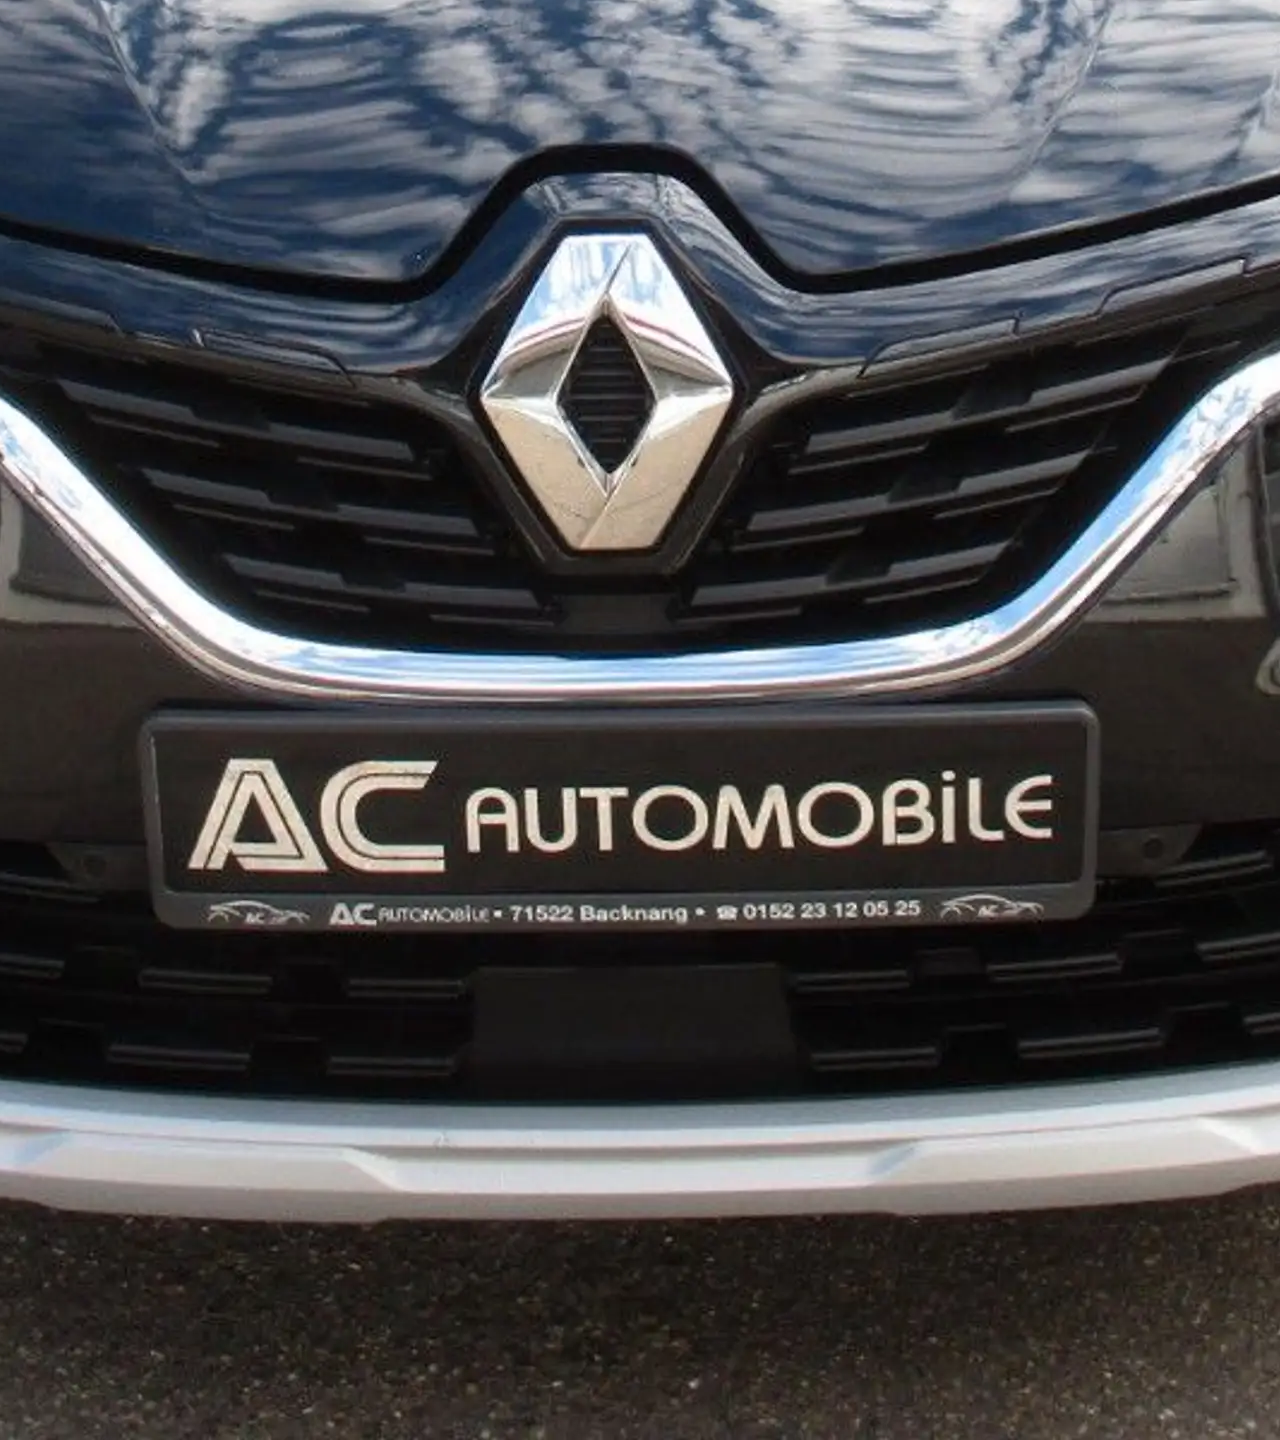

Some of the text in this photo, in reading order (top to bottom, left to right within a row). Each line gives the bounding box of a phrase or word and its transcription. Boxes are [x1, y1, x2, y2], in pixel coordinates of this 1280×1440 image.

[188, 758, 445, 872] AC
[329, 902, 378, 927] AC
[510, 904, 574, 922] 71522
[579, 904, 689, 924] Backnang
[742, 903, 795, 920] 0152
[800, 902, 827, 919] 23
[832, 901, 858, 918] 12
[862, 900, 889, 918] 05
[894, 899, 921, 917] 25
